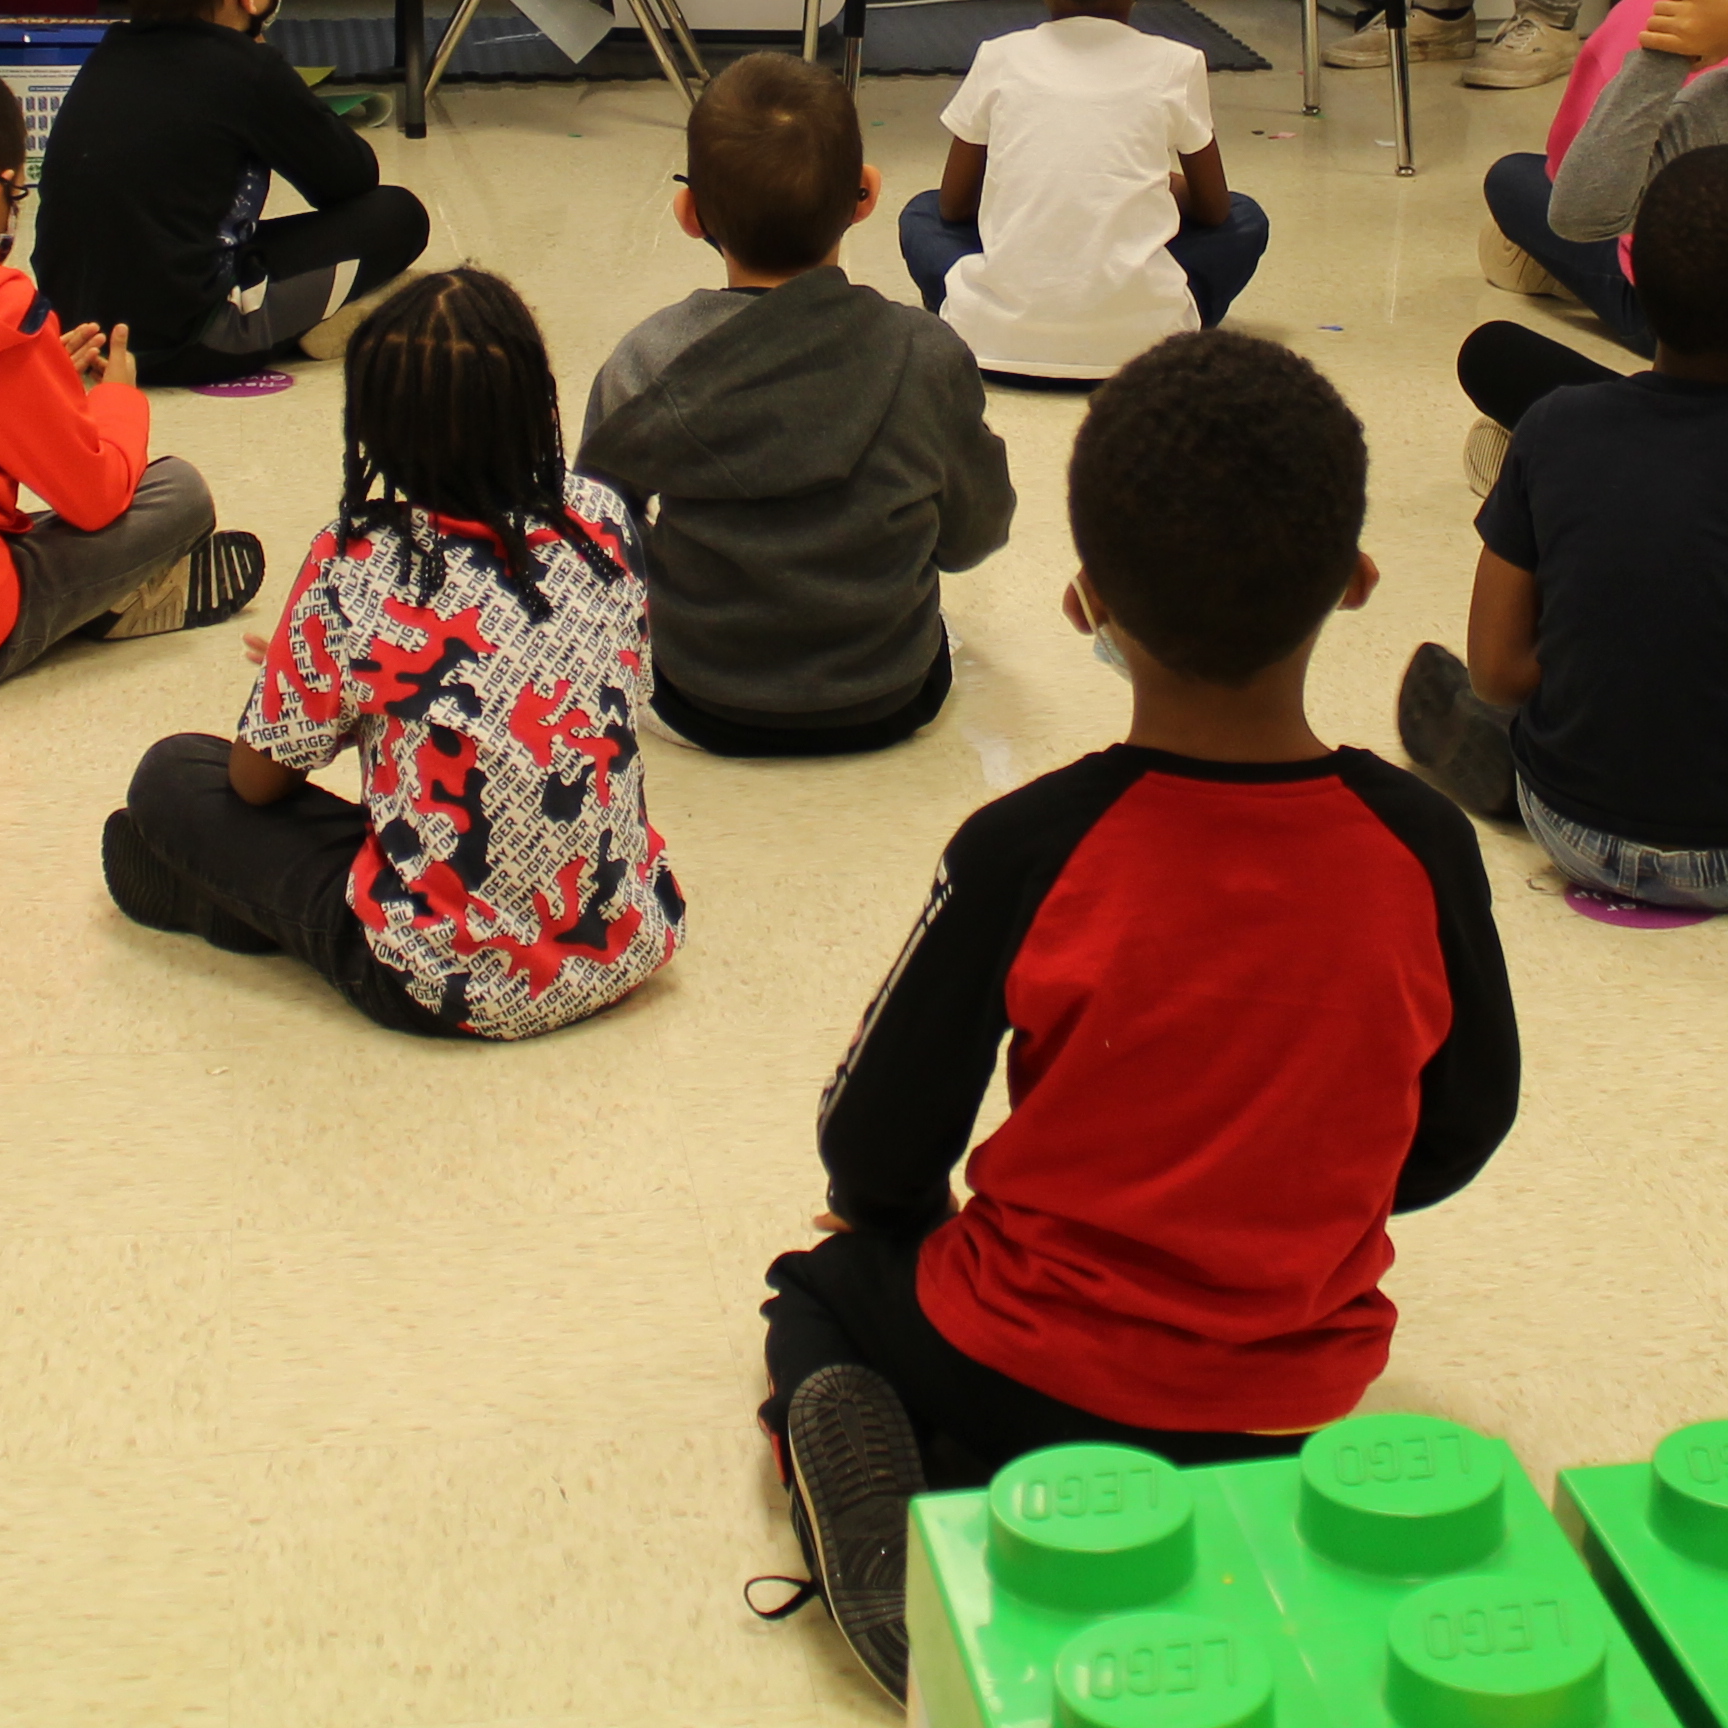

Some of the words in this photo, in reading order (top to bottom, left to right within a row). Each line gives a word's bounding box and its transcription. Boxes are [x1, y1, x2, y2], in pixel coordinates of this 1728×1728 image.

[348, 568, 373, 617] TOMMY
[575, 585, 612, 639] HILFIGER
[347, 589, 383, 653] HILFIGER
[542, 605, 583, 665] HILFIGER
[584, 615, 612, 655] TOMMY
[506, 630, 550, 689] HILFIGER
[549, 634, 582, 680] TOMMY
[583, 633, 614, 688] HILFIGER
[478, 686, 514, 732] TOMMY
[275, 733, 335, 756] HILFIGER
[517, 769, 551, 815] TOMMY
[511, 822, 551, 868] TOMMY
[1333, 1434, 1473, 1486] LEGO
[1020, 1466, 1160, 1521] LEGO
[1424, 1598, 1573, 1662] LEGO
[1088, 1638, 1237, 1700] LEGO
